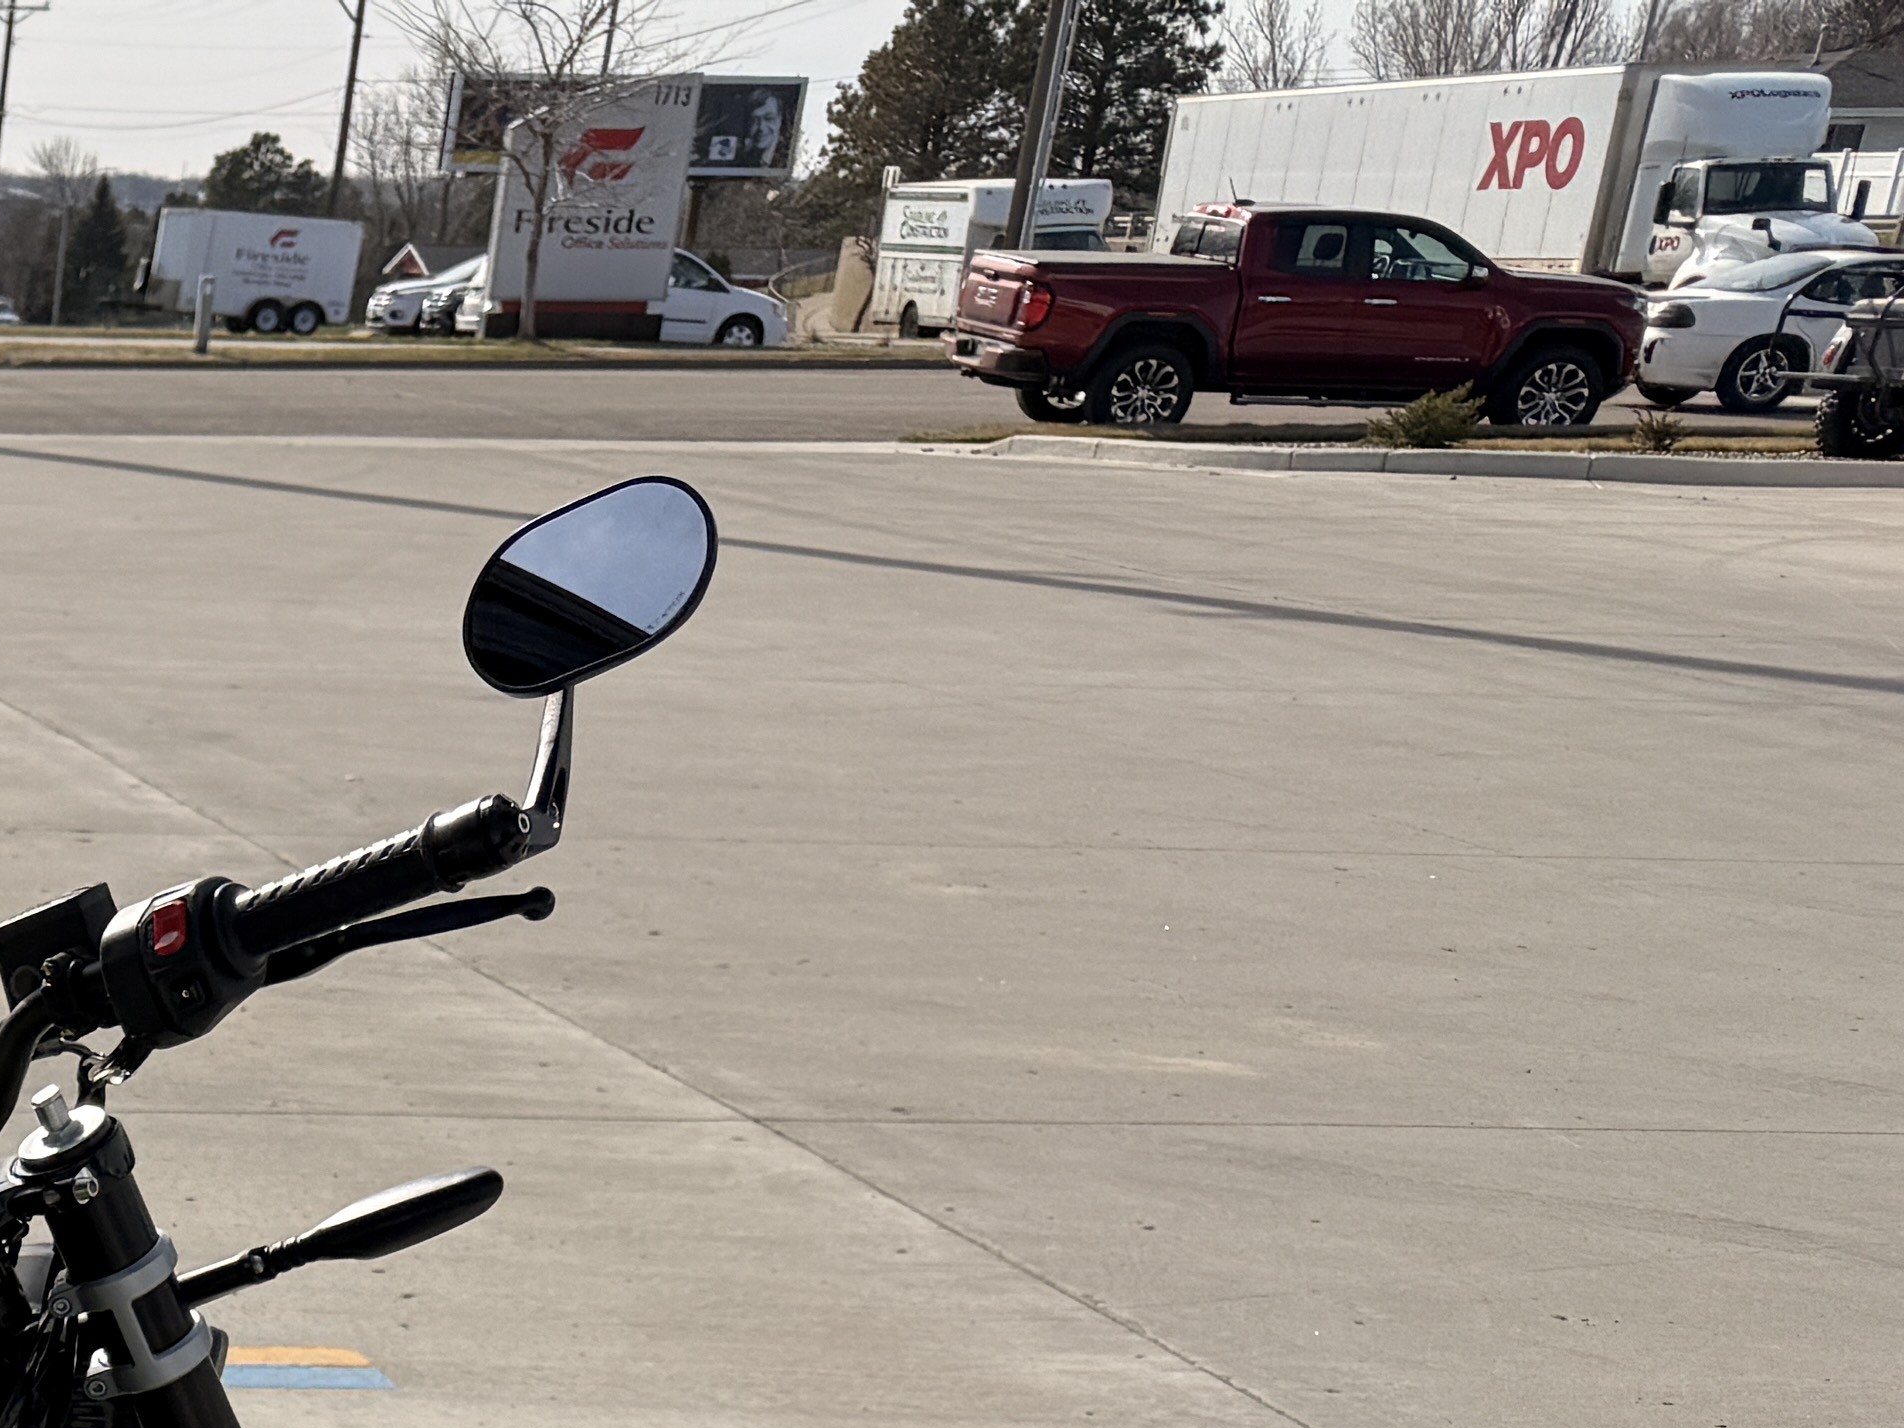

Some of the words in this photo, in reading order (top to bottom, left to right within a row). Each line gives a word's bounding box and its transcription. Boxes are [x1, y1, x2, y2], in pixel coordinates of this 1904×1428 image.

[655, 84, 692, 106] 1713
[1476, 116, 1585, 190] XPO
[514, 208, 655, 234] Freside
[1658, 236, 1681, 250] XPO
